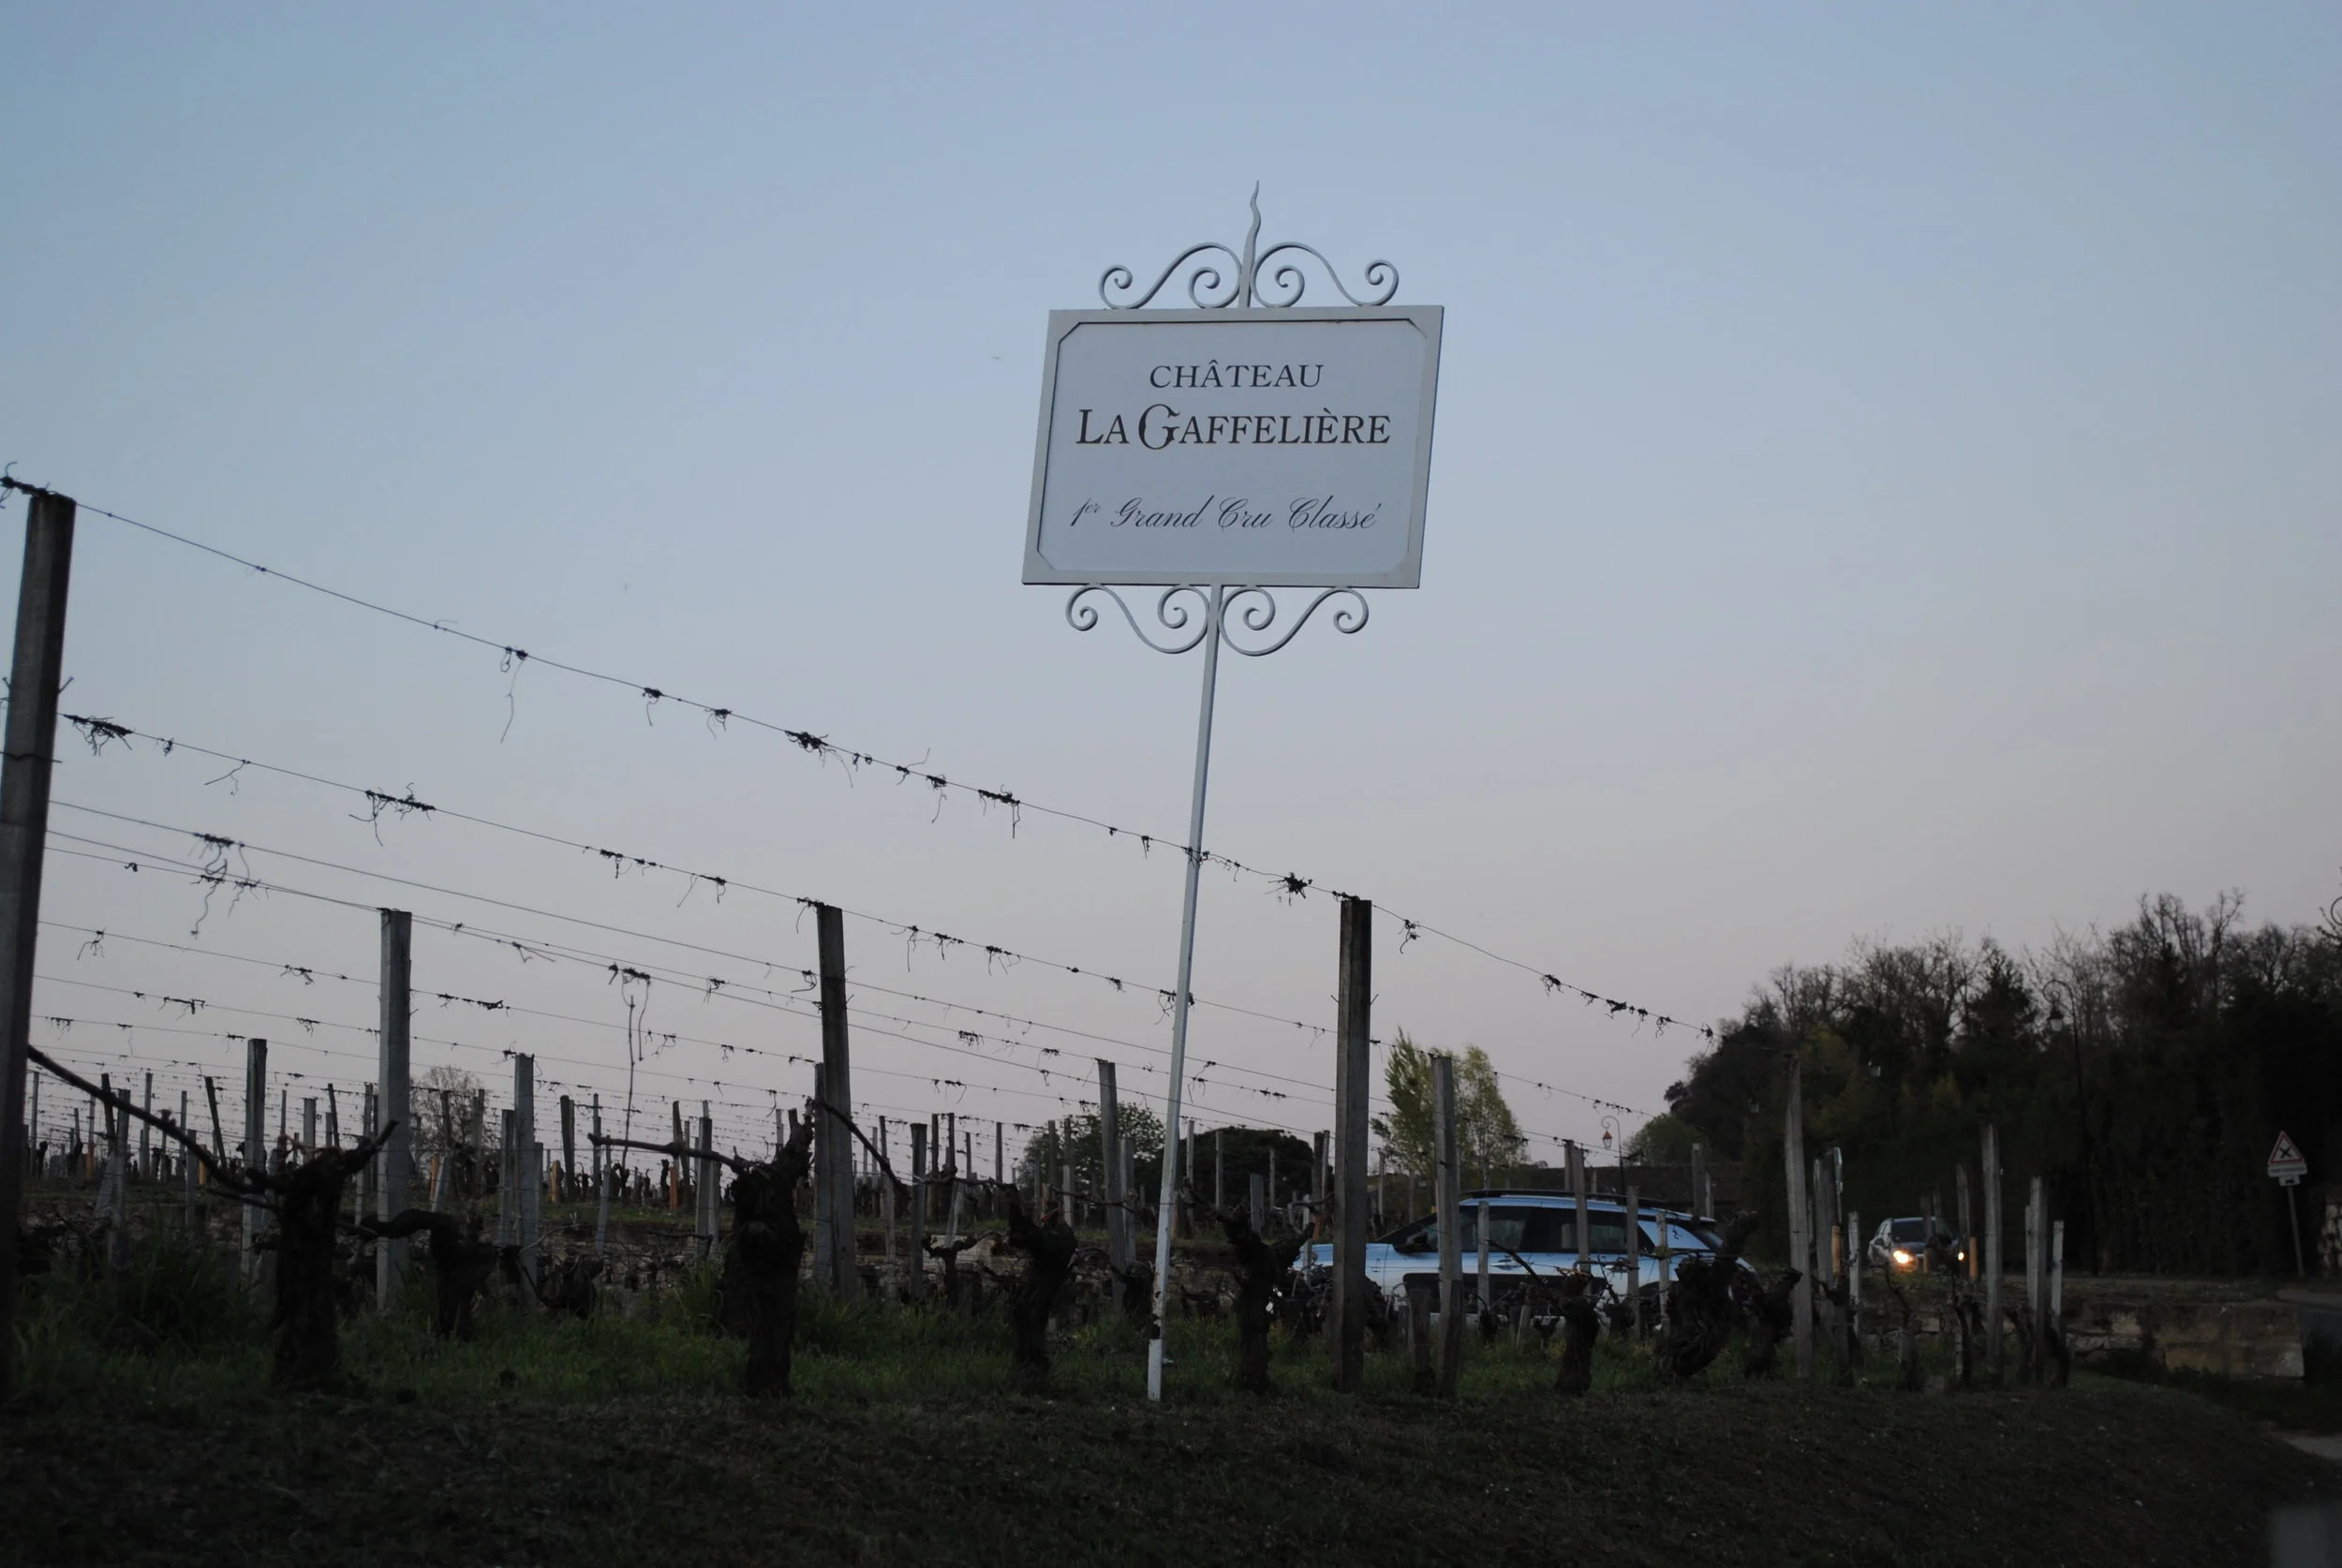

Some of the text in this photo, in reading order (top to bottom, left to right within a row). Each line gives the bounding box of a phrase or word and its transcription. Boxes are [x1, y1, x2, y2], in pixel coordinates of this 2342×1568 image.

[1149, 359, 1325, 389] CHÂTEAU
[1075, 404, 1391, 451] LA GAFFELIÈRE
[1110, 495, 1215, 528] Grand
[1218, 497, 1273, 532] Cru
[1288, 495, 1382, 532] Classé
